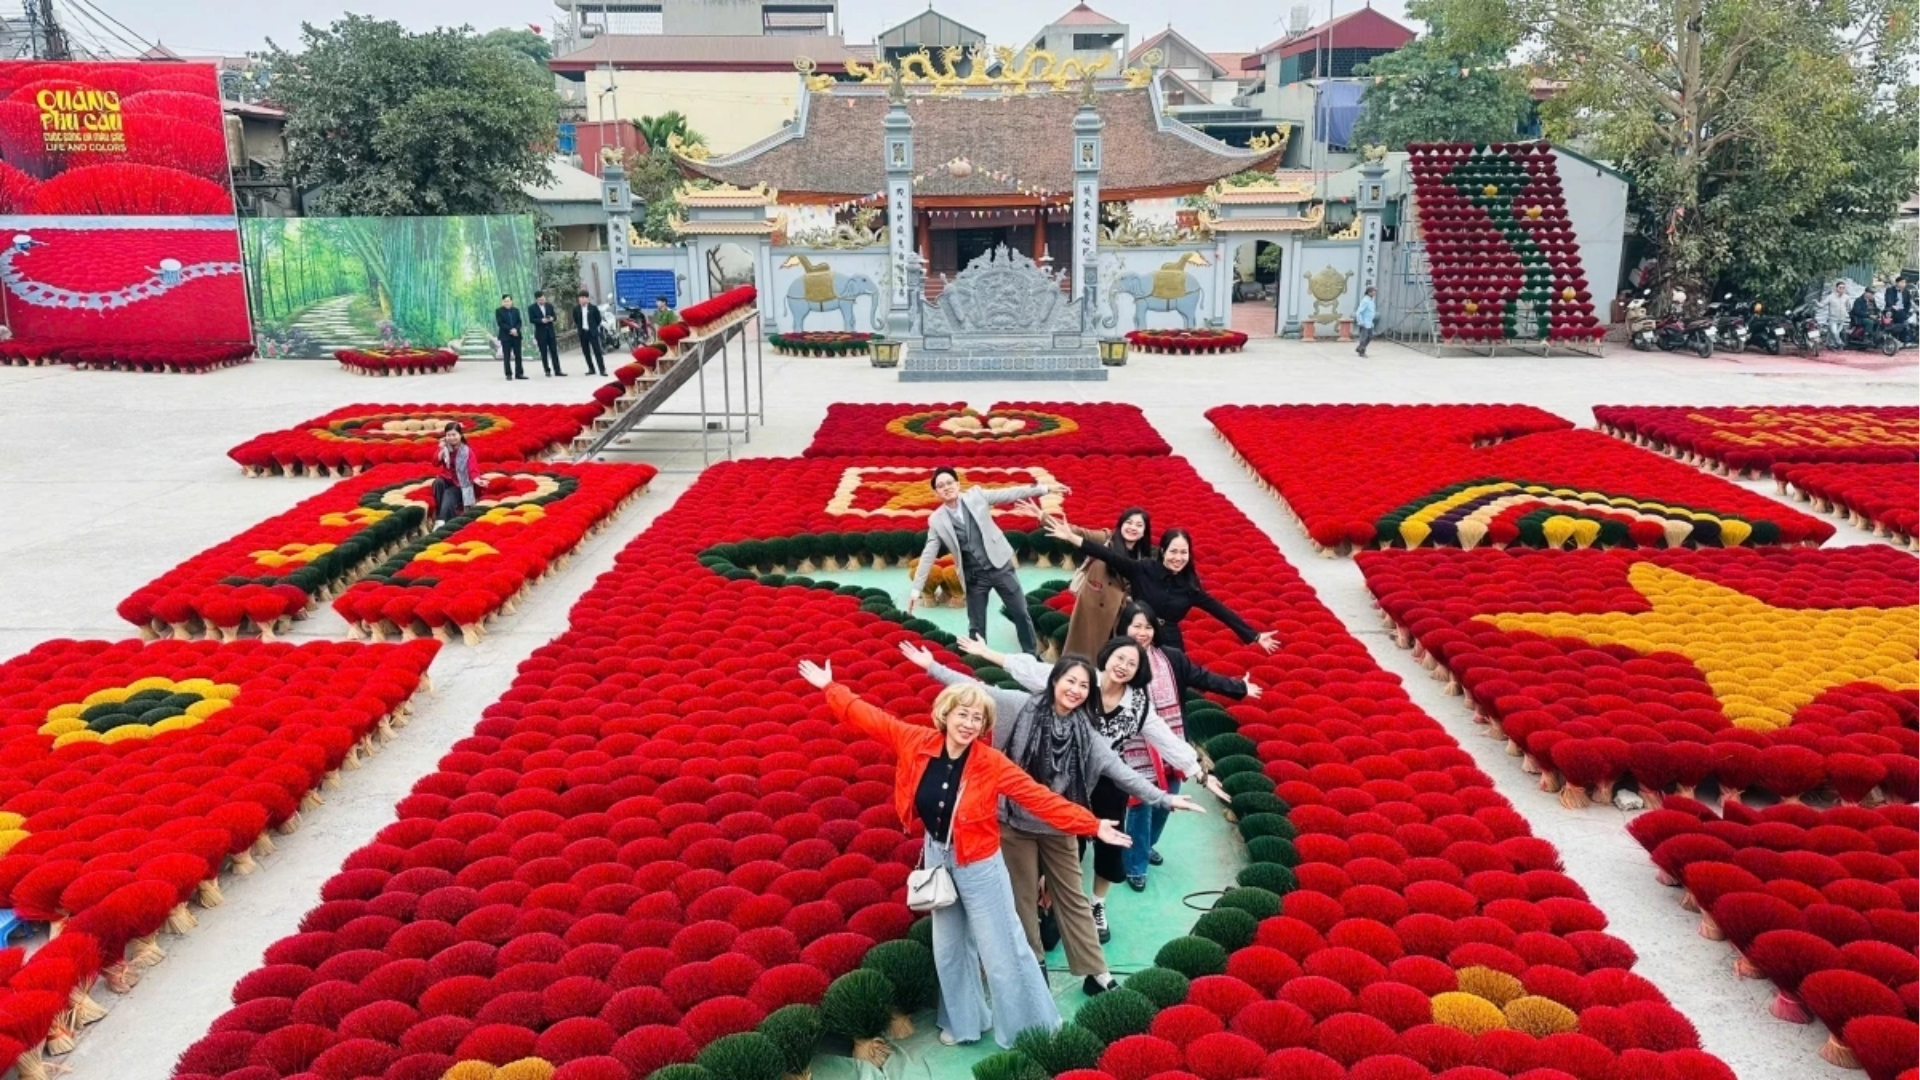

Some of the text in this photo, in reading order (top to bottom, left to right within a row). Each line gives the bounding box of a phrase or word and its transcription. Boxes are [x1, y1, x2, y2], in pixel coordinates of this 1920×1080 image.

[46, 143, 127, 152] LIFE AND COLORS
